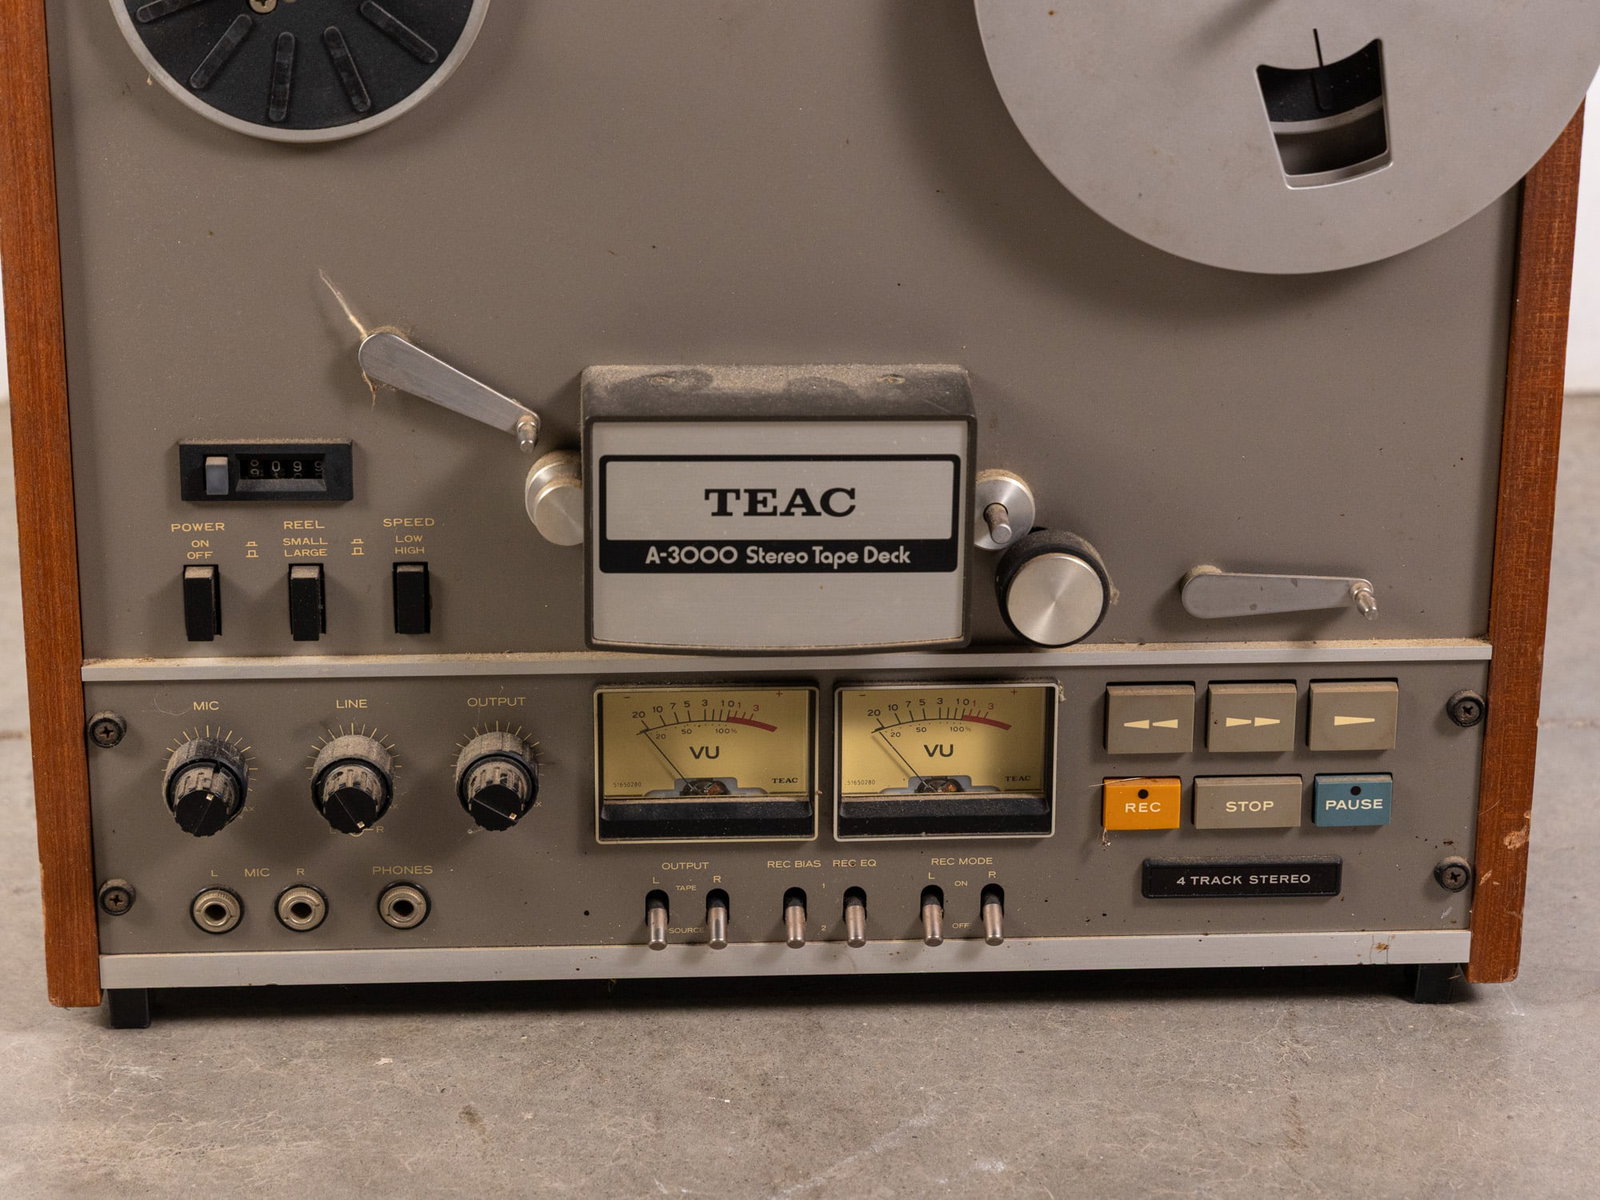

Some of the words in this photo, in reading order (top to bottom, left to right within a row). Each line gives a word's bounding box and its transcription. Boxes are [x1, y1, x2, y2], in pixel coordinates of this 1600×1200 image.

[704, 487, 856, 517] TEAC
[170, 522, 225, 532] POWER
[283, 520, 326, 530] REEL
[383, 517, 435, 527] SPEED
[191, 539, 210, 548] ON
[282, 537, 328, 546] SMALL
[395, 535, 423, 543] LOW
[284, 548, 328, 557] LARGE
[394, 546, 425, 554] HIGH
[186, 551, 213, 560] OFF
[645, 546, 738, 565] A-3000
[746, 546, 808, 565] Stereo
[812, 546, 859, 570] Tape
[863, 545, 911, 564] Deck
[193, 701, 220, 711] MIC
[336, 699, 368, 709] LINE
[467, 697, 526, 707] OUTPUT
[867, 709, 881, 717] 20
[888, 704, 899, 712] 10
[988, 702, 995, 710] 3
[631, 711, 646, 719] 20
[689, 746, 720, 760] VU
[923, 744, 954, 758] VU
[1125, 802, 1161, 813] REC
[1225, 800, 1274, 812] STOP
[1326, 798, 1383, 811] PAUSE
[661, 861, 710, 870] OUTPUT
[767, 860, 791, 868] REC
[794, 860, 822, 868] BIAS
[832, 859, 856, 868] REC
[860, 859, 877, 868] EQ
[931, 857, 955, 866] REC
[959, 857, 993, 865] MODE
[211, 869, 218, 877] L
[244, 868, 270, 877] MIC
[296, 868, 305, 876] R
[372, 865, 433, 875] PHONES
[713, 875, 721, 883] R
[928, 872, 935, 880] L
[1176, 877, 1186, 886] 4
[1190, 875, 1242, 886] TRACK
[1249, 874, 1311, 884] STEREO
